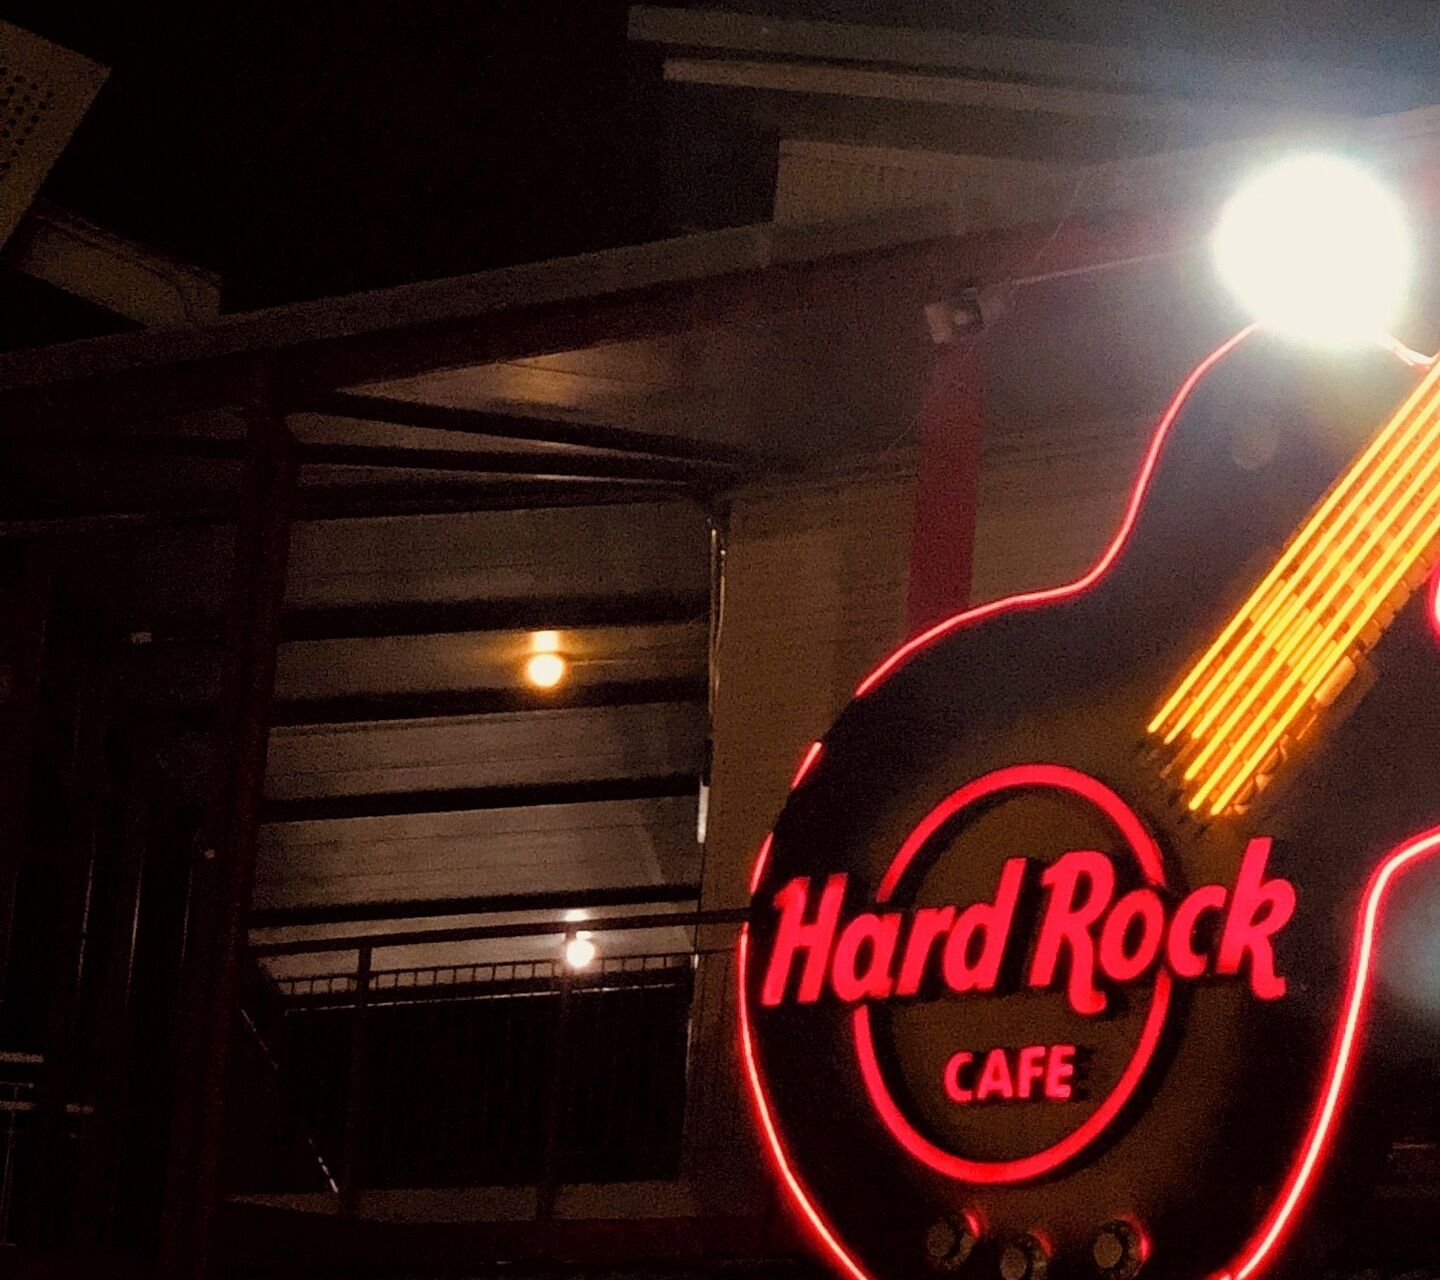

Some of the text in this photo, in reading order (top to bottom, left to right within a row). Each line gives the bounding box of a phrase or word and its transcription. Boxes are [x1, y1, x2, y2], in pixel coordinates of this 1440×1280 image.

[761, 836, 1296, 1015] Hard Rock
[944, 1043, 1075, 1102] CAFE
